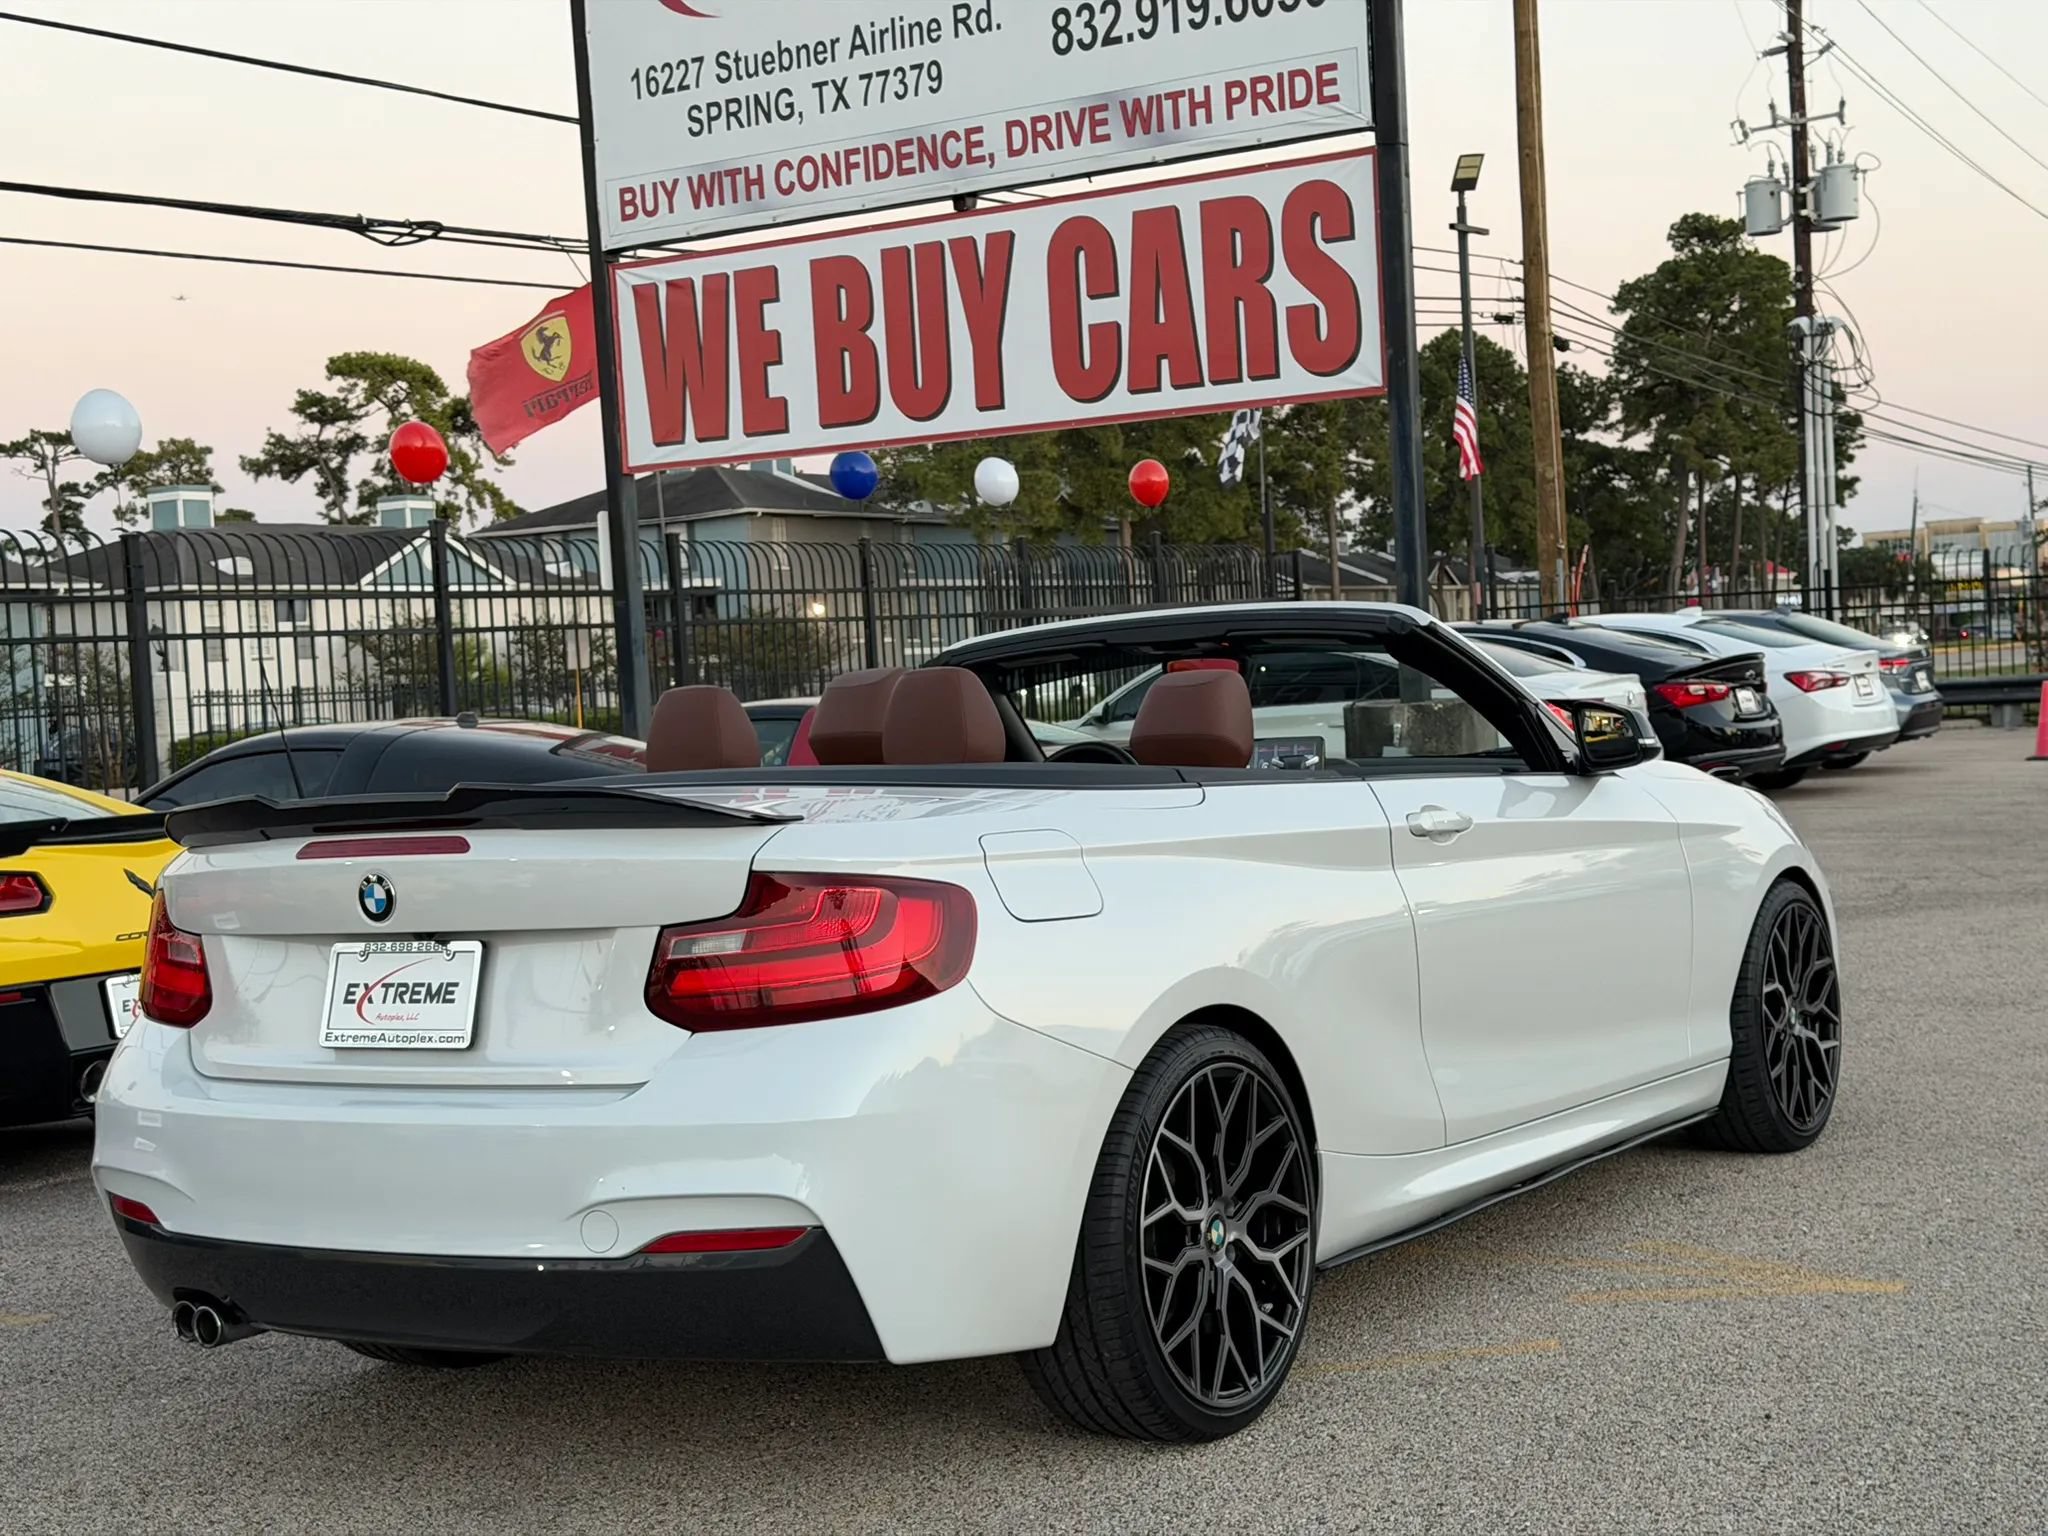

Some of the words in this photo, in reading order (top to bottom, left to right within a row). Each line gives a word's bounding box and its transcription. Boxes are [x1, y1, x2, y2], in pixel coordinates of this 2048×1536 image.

[630, 57, 704, 100] 16227
[714, 37, 840, 84] Stuebner
[848, 17, 942, 60] Airline
[953, 0, 1003, 39] Rd.
[619, 177, 680, 222] BUY
[687, 164, 765, 210] WITH
[774, 126, 996, 196] CONFIDENCE,
[1006, 103, 1111, 158] DRIVE
[1119, 85, 1212, 138] WITH
[1224, 62, 1340, 121] PRIDE
[687, 87, 803, 137] SPRING,
[812, 76, 851, 115] TX
[858, 60, 943, 107] 77379
[631, 264, 789, 448] WE
[809, 229, 1016, 429] BUY
[1046, 179, 1362, 403] CARS
[343, 982, 460, 1005] EXTREME
[324, 1032, 465, 1045] ExtremeAutoplex.com
